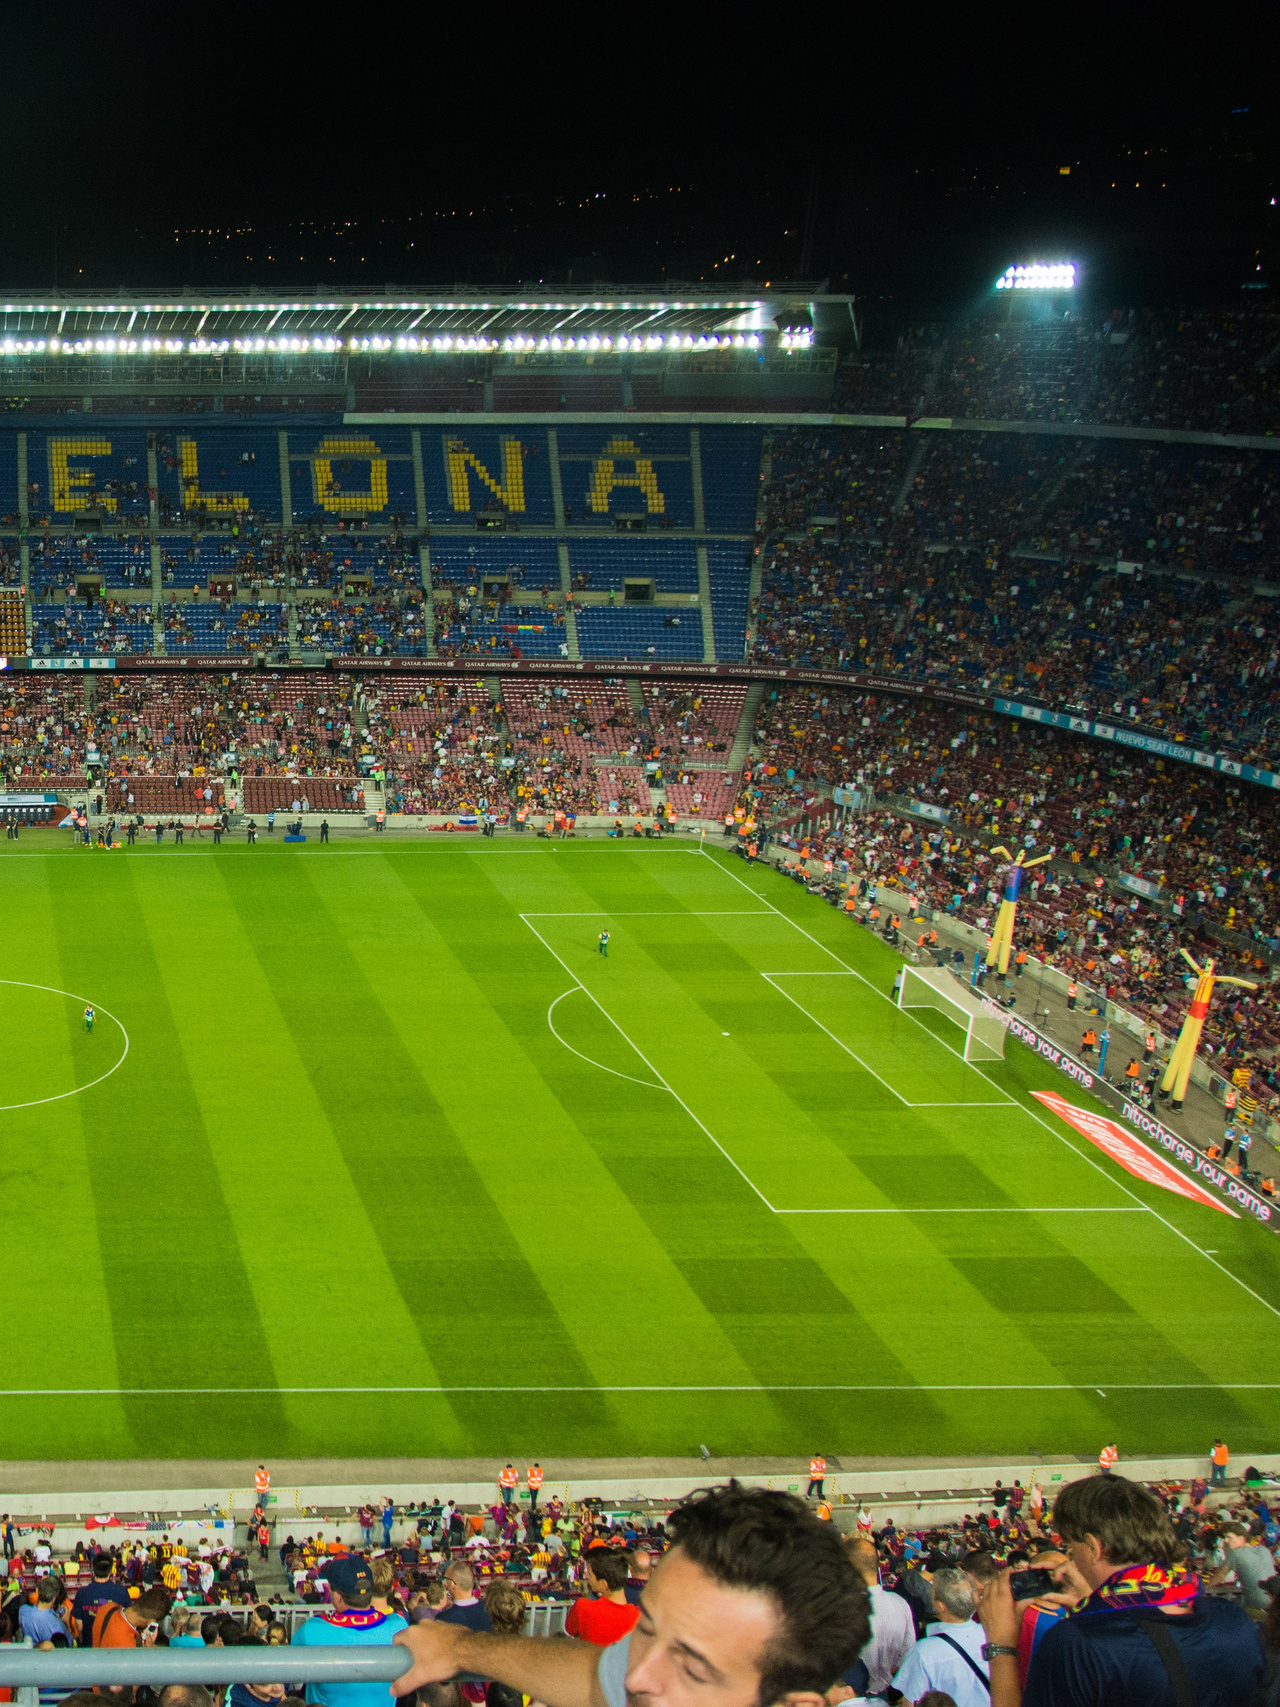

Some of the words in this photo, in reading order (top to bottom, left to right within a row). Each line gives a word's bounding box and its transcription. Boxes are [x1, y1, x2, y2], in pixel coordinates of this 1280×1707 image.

[729, 667, 750, 675] QATAR
[750, 668, 778, 676] AIRWAYS
[798, 671, 820, 679] QATAR
[820, 673, 848, 682] AIRWAYS
[867, 678, 889, 687] QATAR
[889, 680, 916, 691] AIRWAYS
[934, 689, 953, 699] QATAR
[1116, 731, 1145, 747] NUEVO
[1146, 739, 1168, 753] SEAT
[1036, 1037, 1061, 1063] your
[1060, 1056, 1094, 1088] game
[1122, 1102, 1195, 1164] nitrocharge
[1195, 1156, 1228, 1188] your
[1227, 1181, 1272, 1220] game
